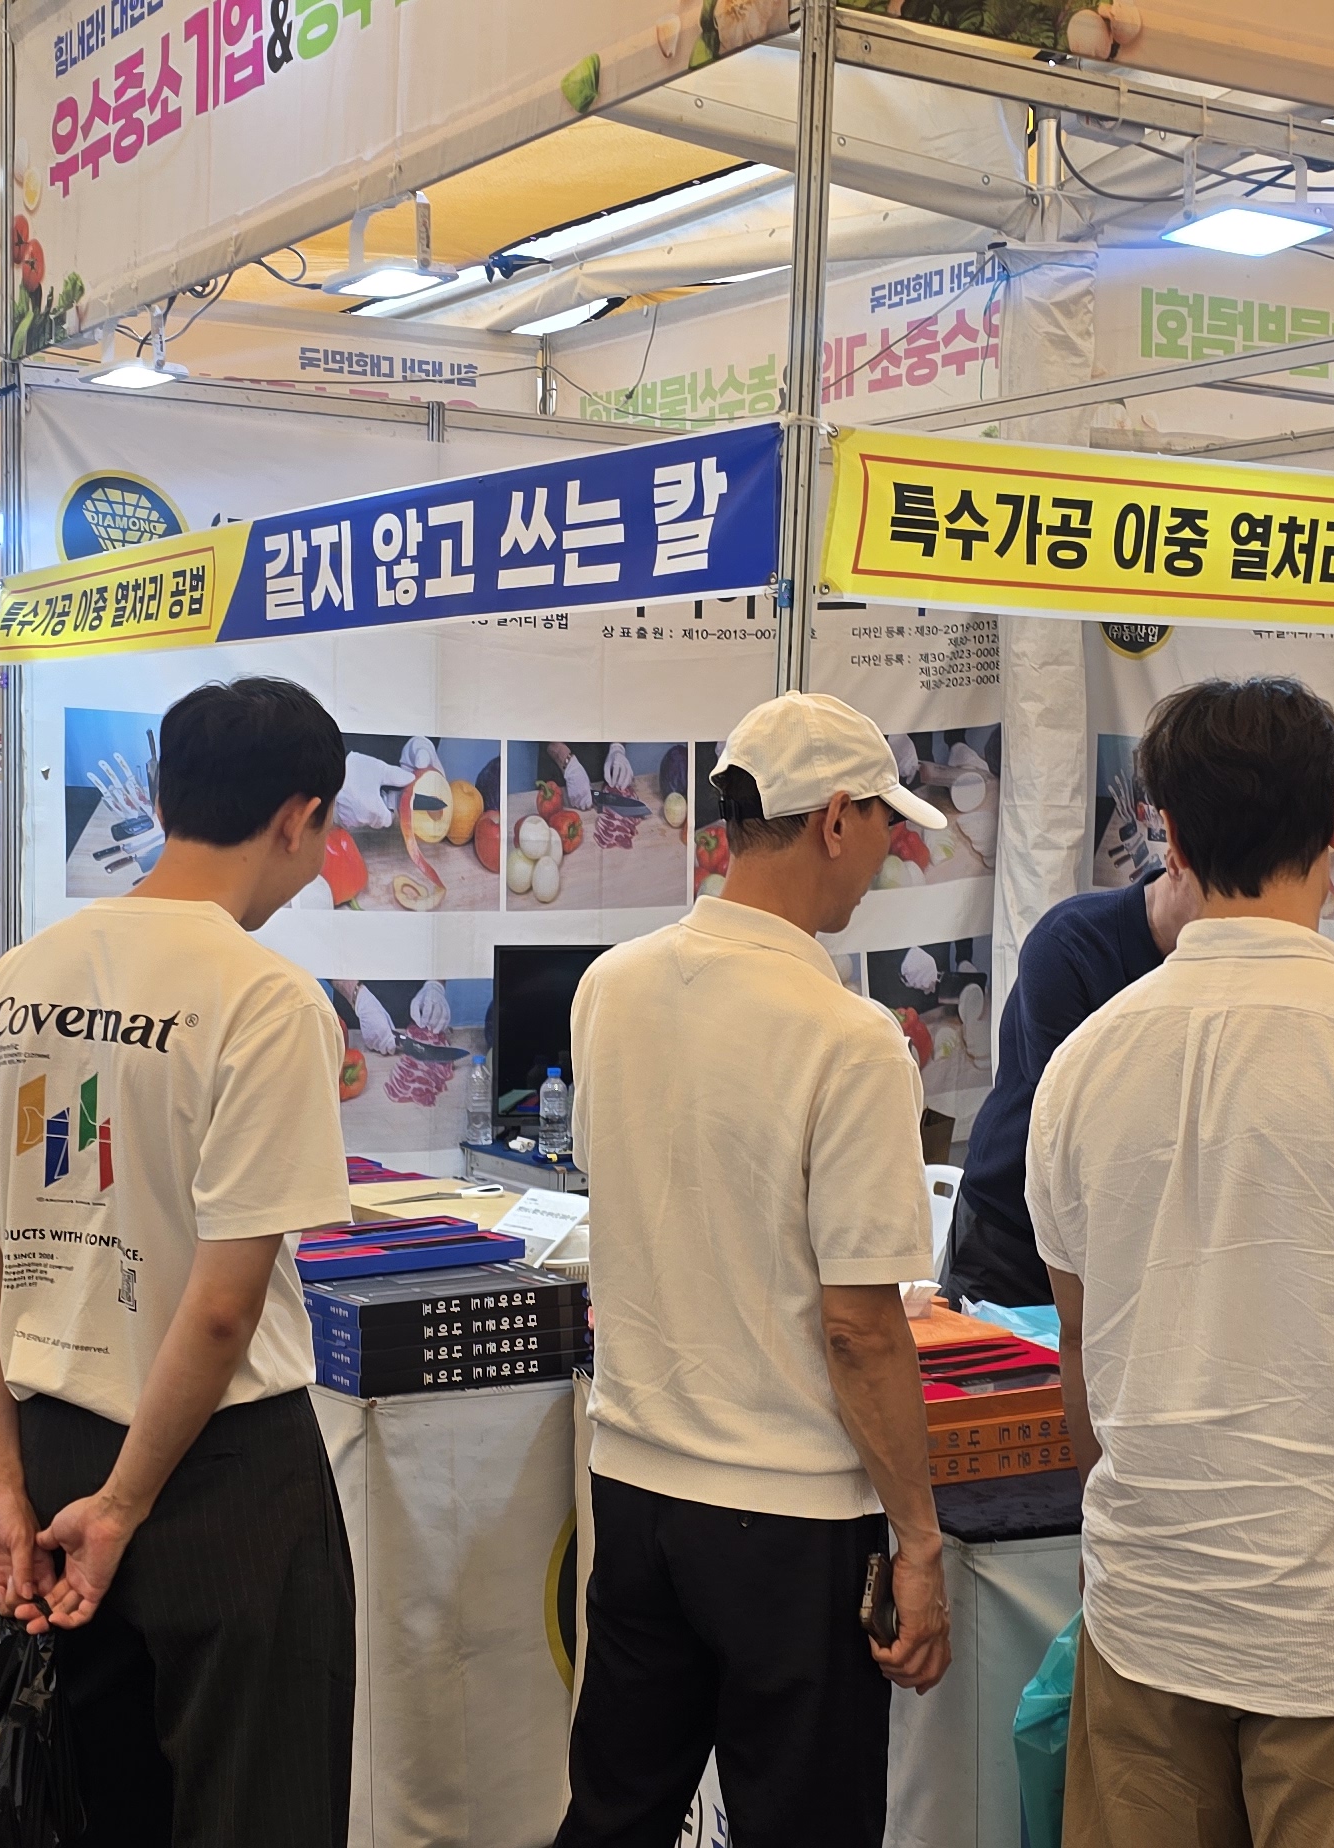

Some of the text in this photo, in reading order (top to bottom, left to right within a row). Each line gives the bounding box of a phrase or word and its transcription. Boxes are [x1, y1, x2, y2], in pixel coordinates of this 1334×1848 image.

[54, 5, 106, 78] 힘내라!
[89, 511, 158, 536] DIAMOND
[889, 481, 1093, 571] 특수가공
[1113, 502, 1210, 577] 이중
[0, 456, 727, 637] 특수가공 이중 열처리 공법 갈지 않고 쓰는 칼
[852, 626, 882, 639] 디자인
[884, 625, 905, 638] 등록
[851, 653, 881, 667] 디자인
[884, 653, 904, 666] 등록
[50, 1230, 83, 1243] WITH
[422, 1292, 536, 1316] 다이아몬드 나이프
[424, 1314, 537, 1339] 다이아몬드 나이프
[424, 1337, 537, 1362] 다이아몬드 나이프
[423, 1360, 538, 1386] 다이아몬드 나이프
